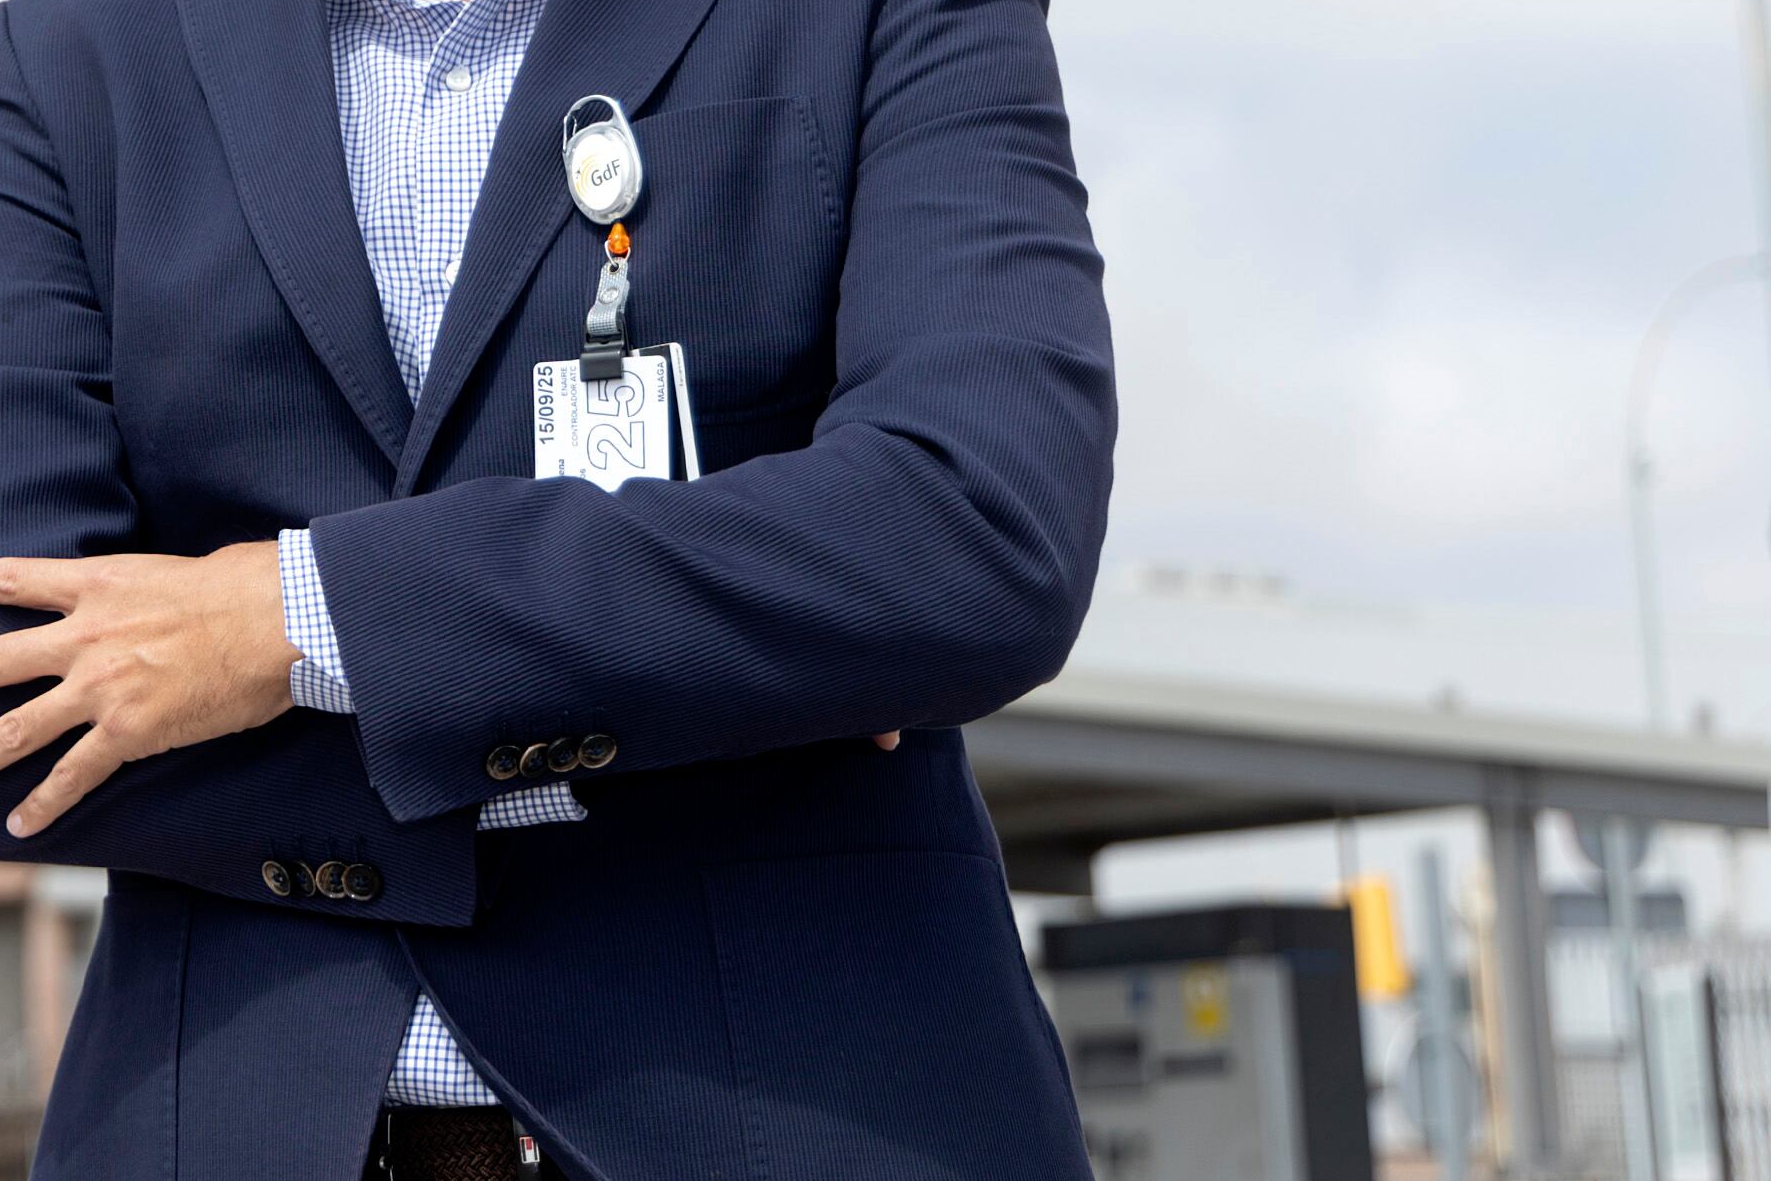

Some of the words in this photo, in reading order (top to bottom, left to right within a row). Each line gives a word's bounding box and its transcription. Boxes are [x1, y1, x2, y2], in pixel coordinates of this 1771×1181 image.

[591, 159, 621, 187] GdF
[560, 366, 568, 397] ENAIRE
[569, 365, 577, 382] ATC
[657, 361, 665, 402] MALAGA
[538, 365, 555, 445] 15/09/25
[570, 384, 579, 447] CONTROLADOR
[587, 370, 646, 470] 25
